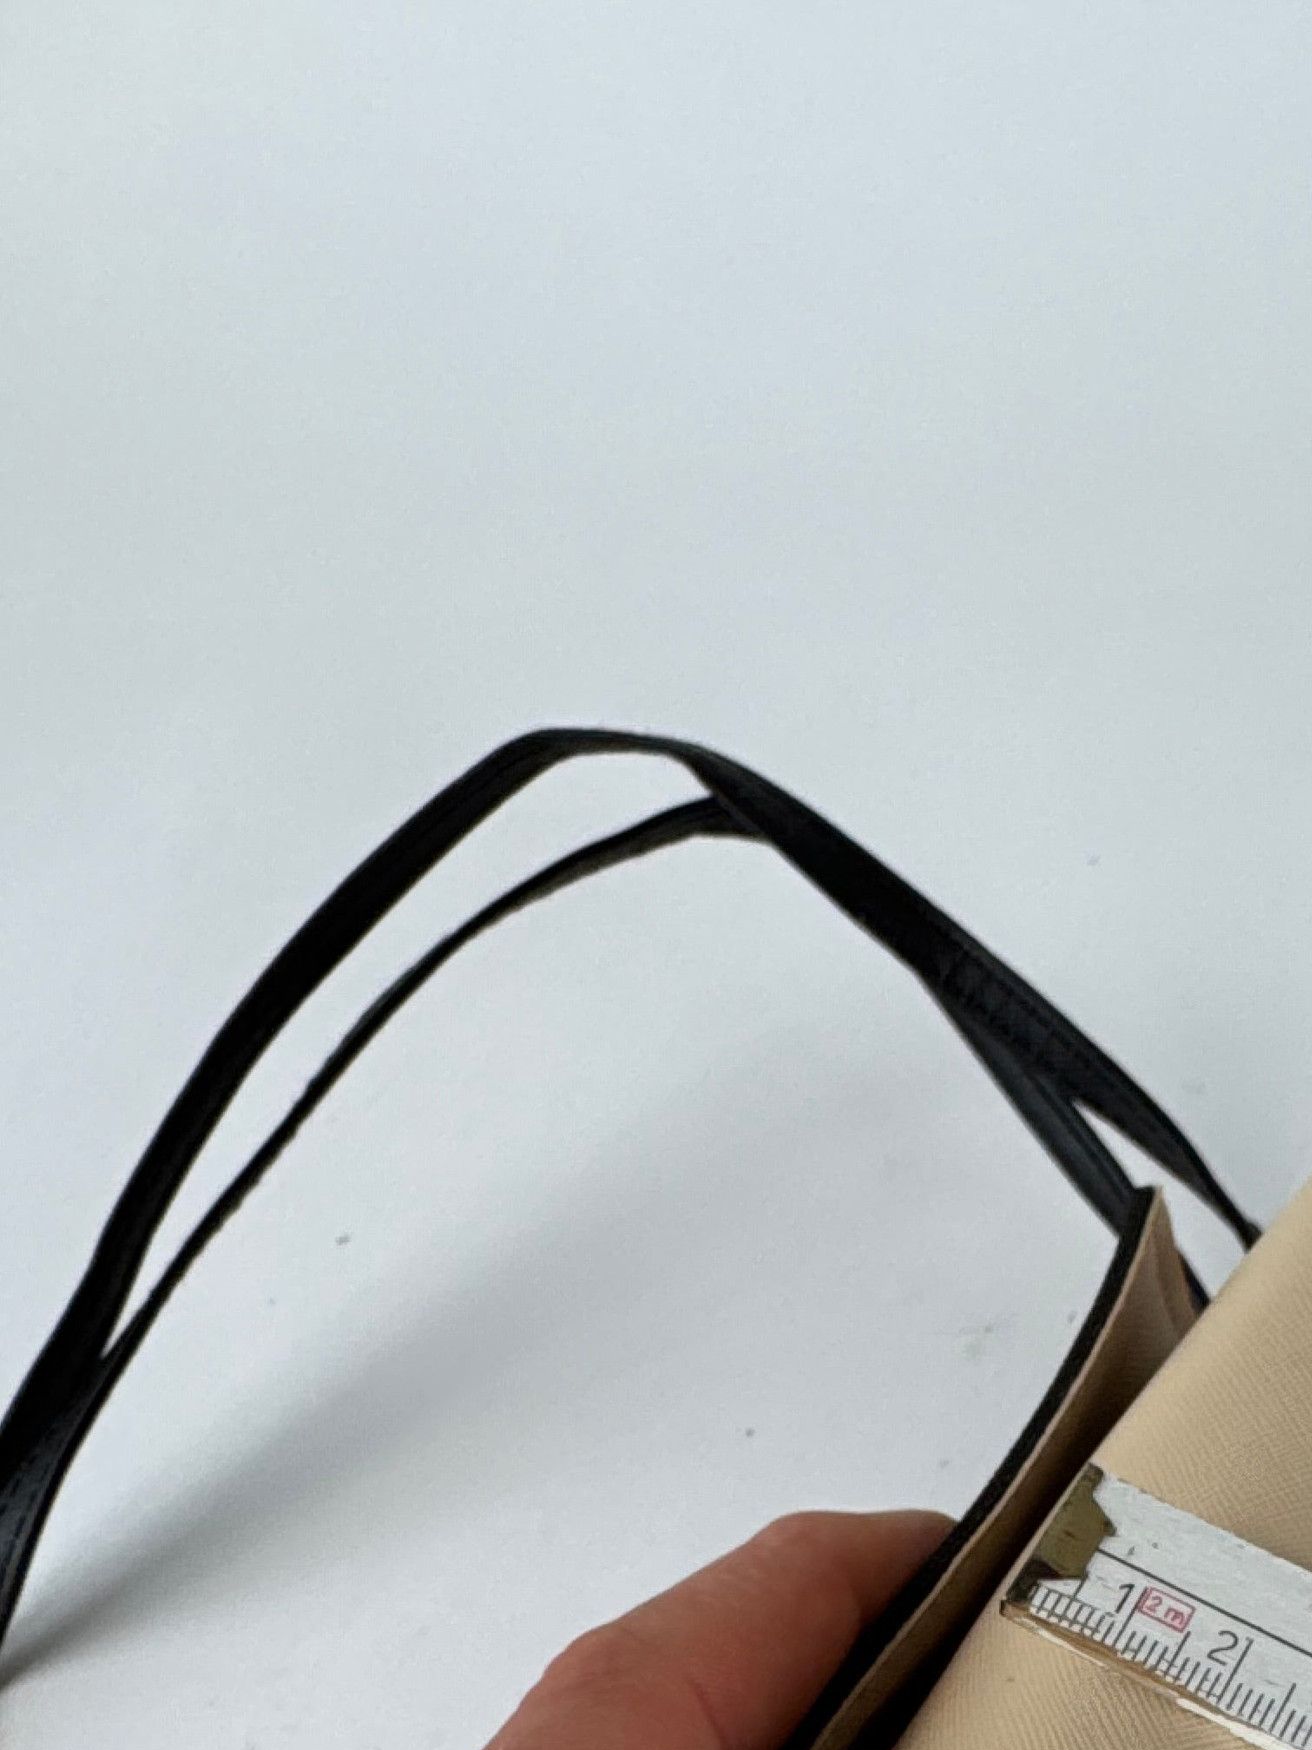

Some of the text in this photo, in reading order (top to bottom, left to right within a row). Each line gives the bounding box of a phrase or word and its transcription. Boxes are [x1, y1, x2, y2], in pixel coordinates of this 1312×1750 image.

[1115, 1583, 1136, 1614] 1
[1207, 1631, 1239, 1666] 2
[1146, 1595, 1185, 1626] 2 m
